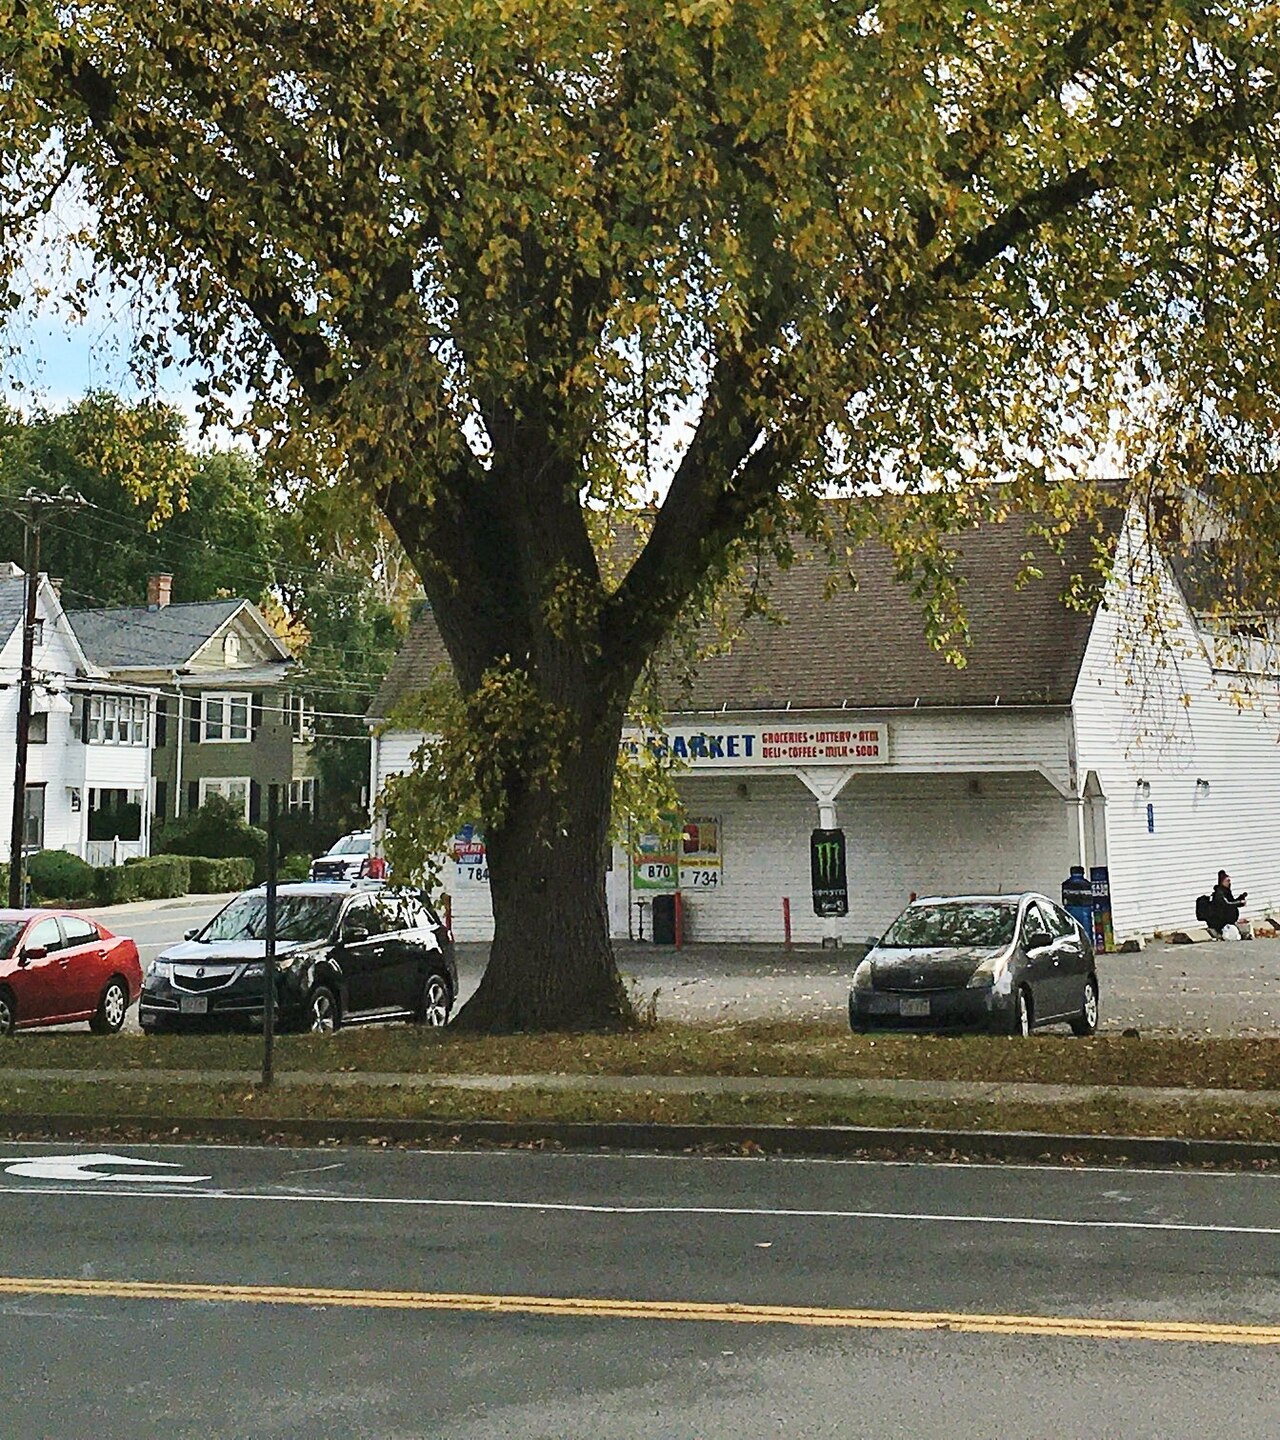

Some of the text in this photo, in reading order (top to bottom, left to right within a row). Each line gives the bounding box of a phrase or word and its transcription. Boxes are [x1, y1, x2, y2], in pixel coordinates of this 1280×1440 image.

[762, 730, 879, 743] GROCERIES LOTTERY ATM
[762, 745, 879, 758] DELI COFFEE MILK SODA
[648, 865, 670, 878] 870
[692, 871, 718, 886] 734
